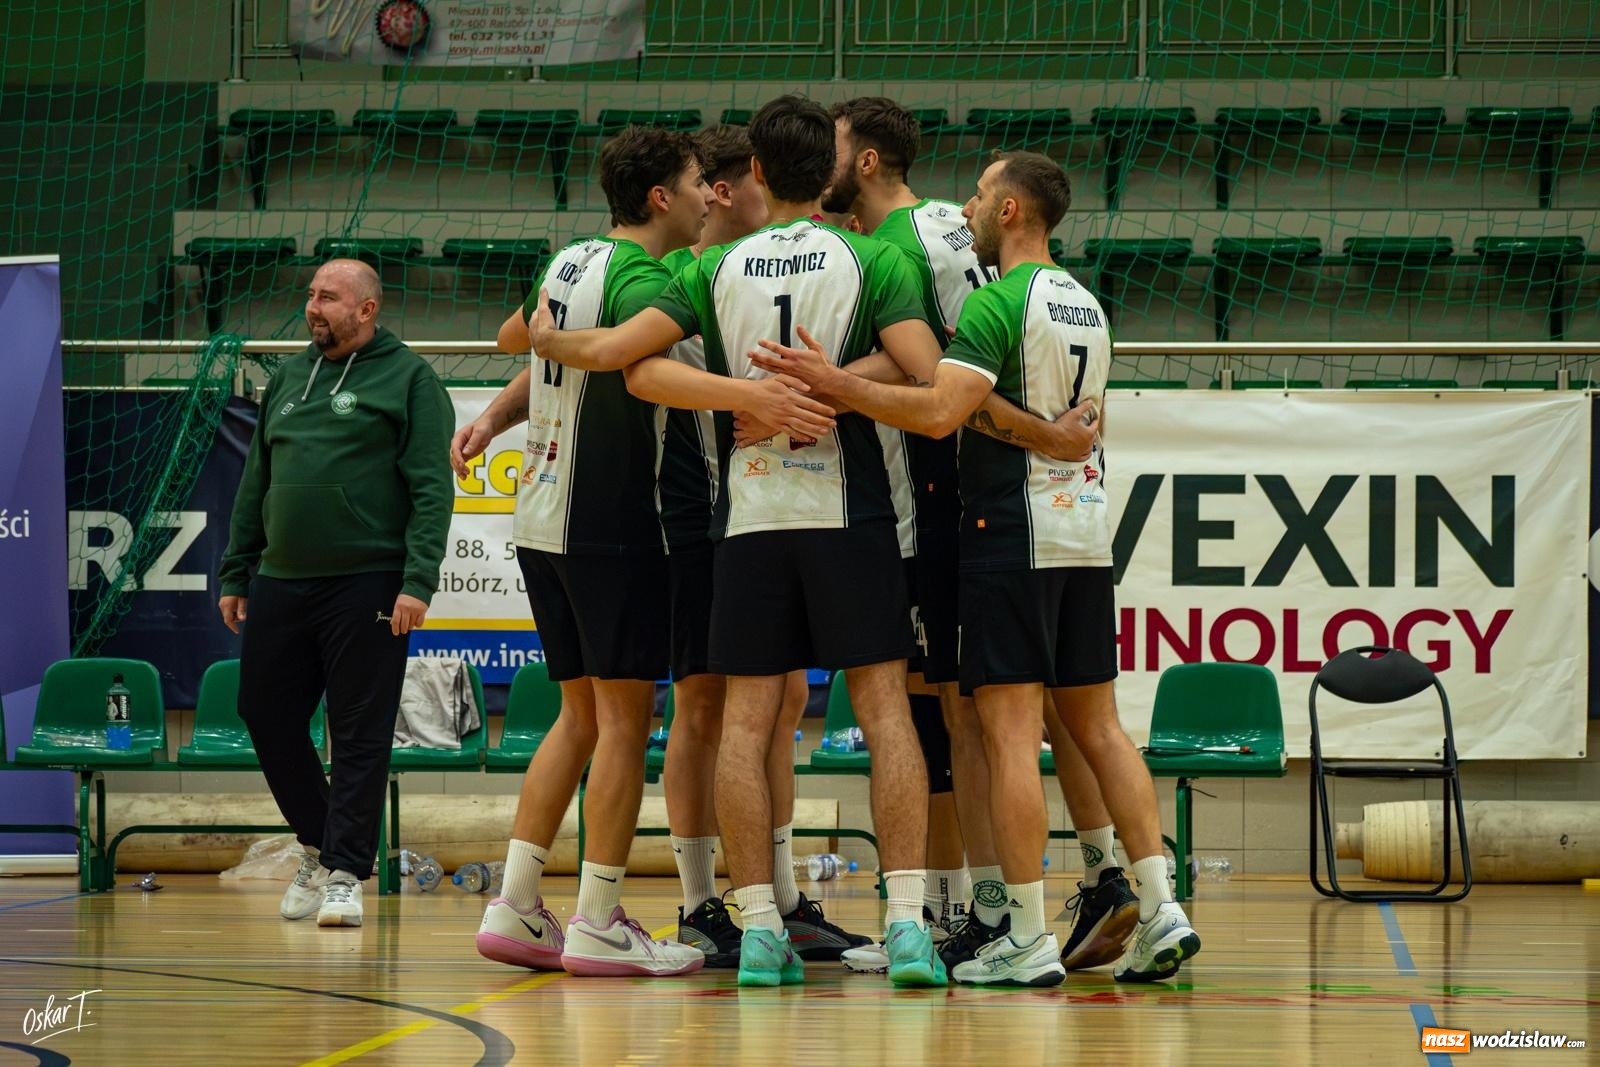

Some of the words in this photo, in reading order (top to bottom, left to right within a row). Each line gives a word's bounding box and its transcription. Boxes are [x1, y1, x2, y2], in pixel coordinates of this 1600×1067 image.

[448, 31, 467, 41] tel.
[470, 31, 494, 41] 032
[743, 251, 827, 278] KRETOWICZ
[774, 294, 792, 356] 1
[1068, 343, 1088, 410] 7
[455, 539, 491, 561] 88,
